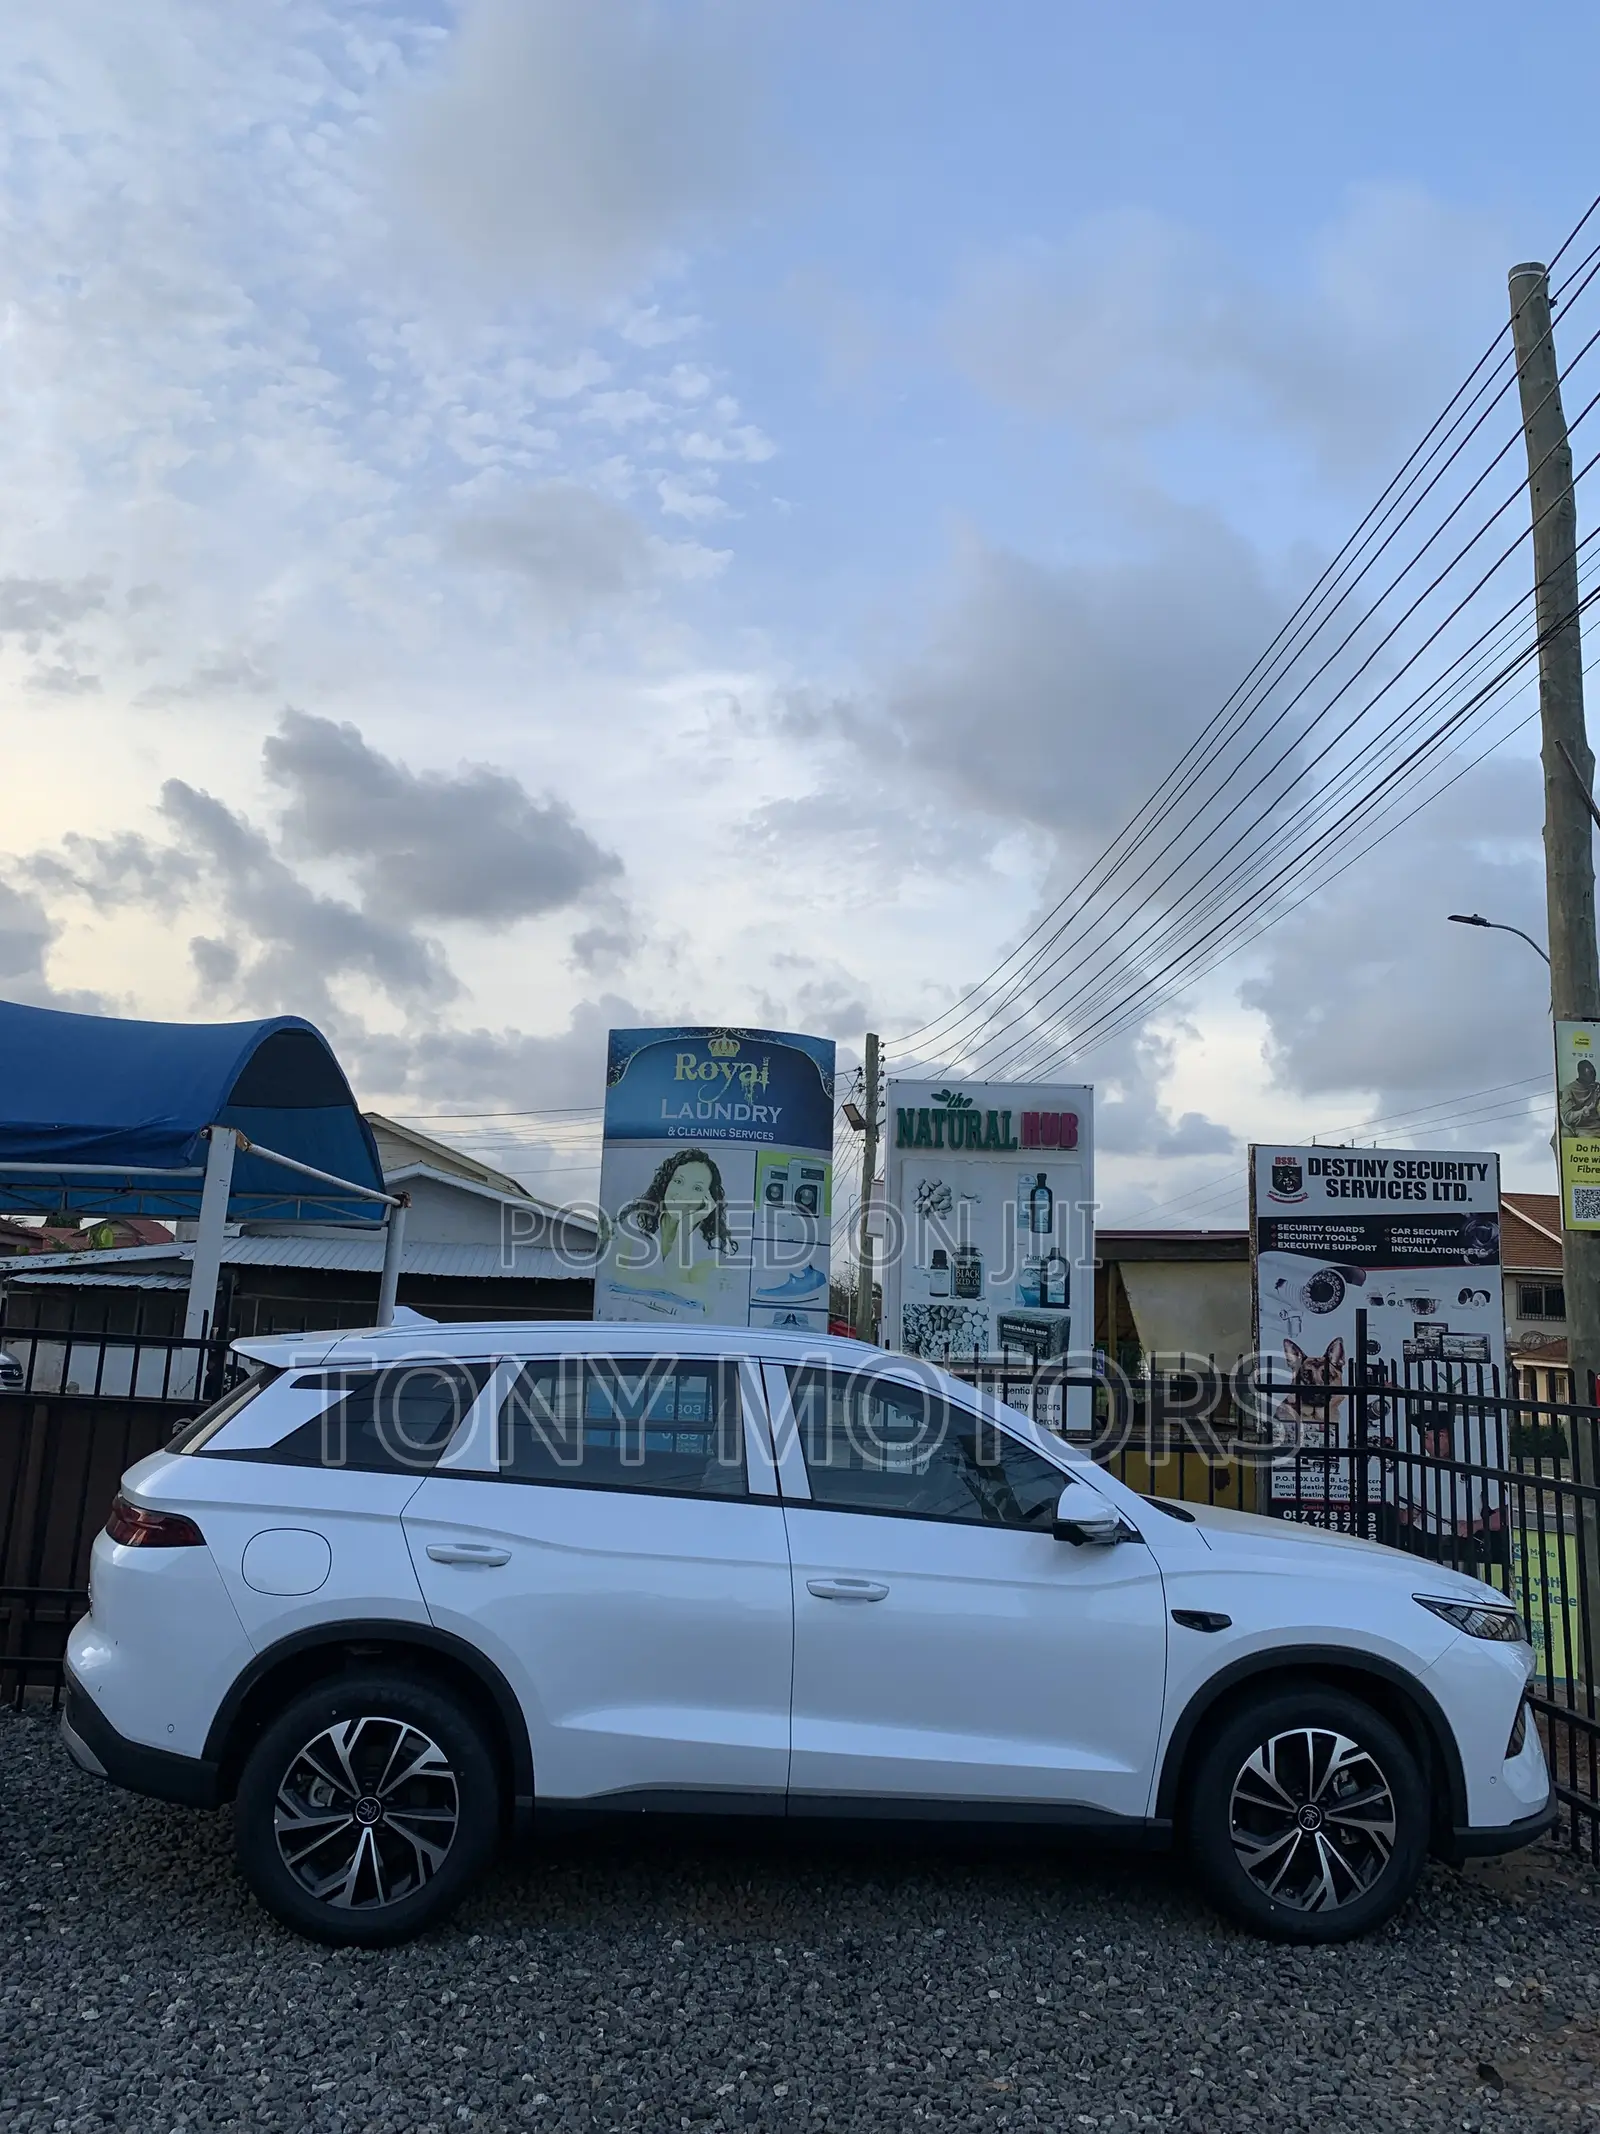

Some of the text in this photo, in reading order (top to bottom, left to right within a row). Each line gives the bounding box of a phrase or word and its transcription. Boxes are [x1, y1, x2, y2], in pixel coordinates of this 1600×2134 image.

[673, 1053, 770, 1104] Royal
[946, 1092, 973, 1109] the
[660, 1099, 783, 1124] LAUNDRY
[667, 1126, 774, 1141] & CLEANING SERVICES
[896, 1107, 1079, 1152] NATURAL HUB
[1576, 1143, 1589, 1153] Do
[1570, 1154, 1590, 1163] love
[1308, 1157, 1488, 1181] DESTINY SECURITY
[1325, 1178, 1427, 1200] SERVICES
[1433, 1181, 1473, 1202] LTD.
[1277, 1223, 1365, 1233] SECURITY GUARDS
[1391, 1227, 1459, 1236] CAR SECURITY
[1277, 1232, 1357, 1242] SECURITY TOOLS
[1391, 1236, 1438, 1245] SECURITY
[1277, 1241, 1377, 1252] EXECUTIVE SUPPORT
[1391, 1245, 1466, 1255] INSTALLATIONS
[955, 1269, 980, 1279] BLACK
[997, 1385, 1033, 1395] Esential
[1035, 1403, 1061, 1412] ugars
